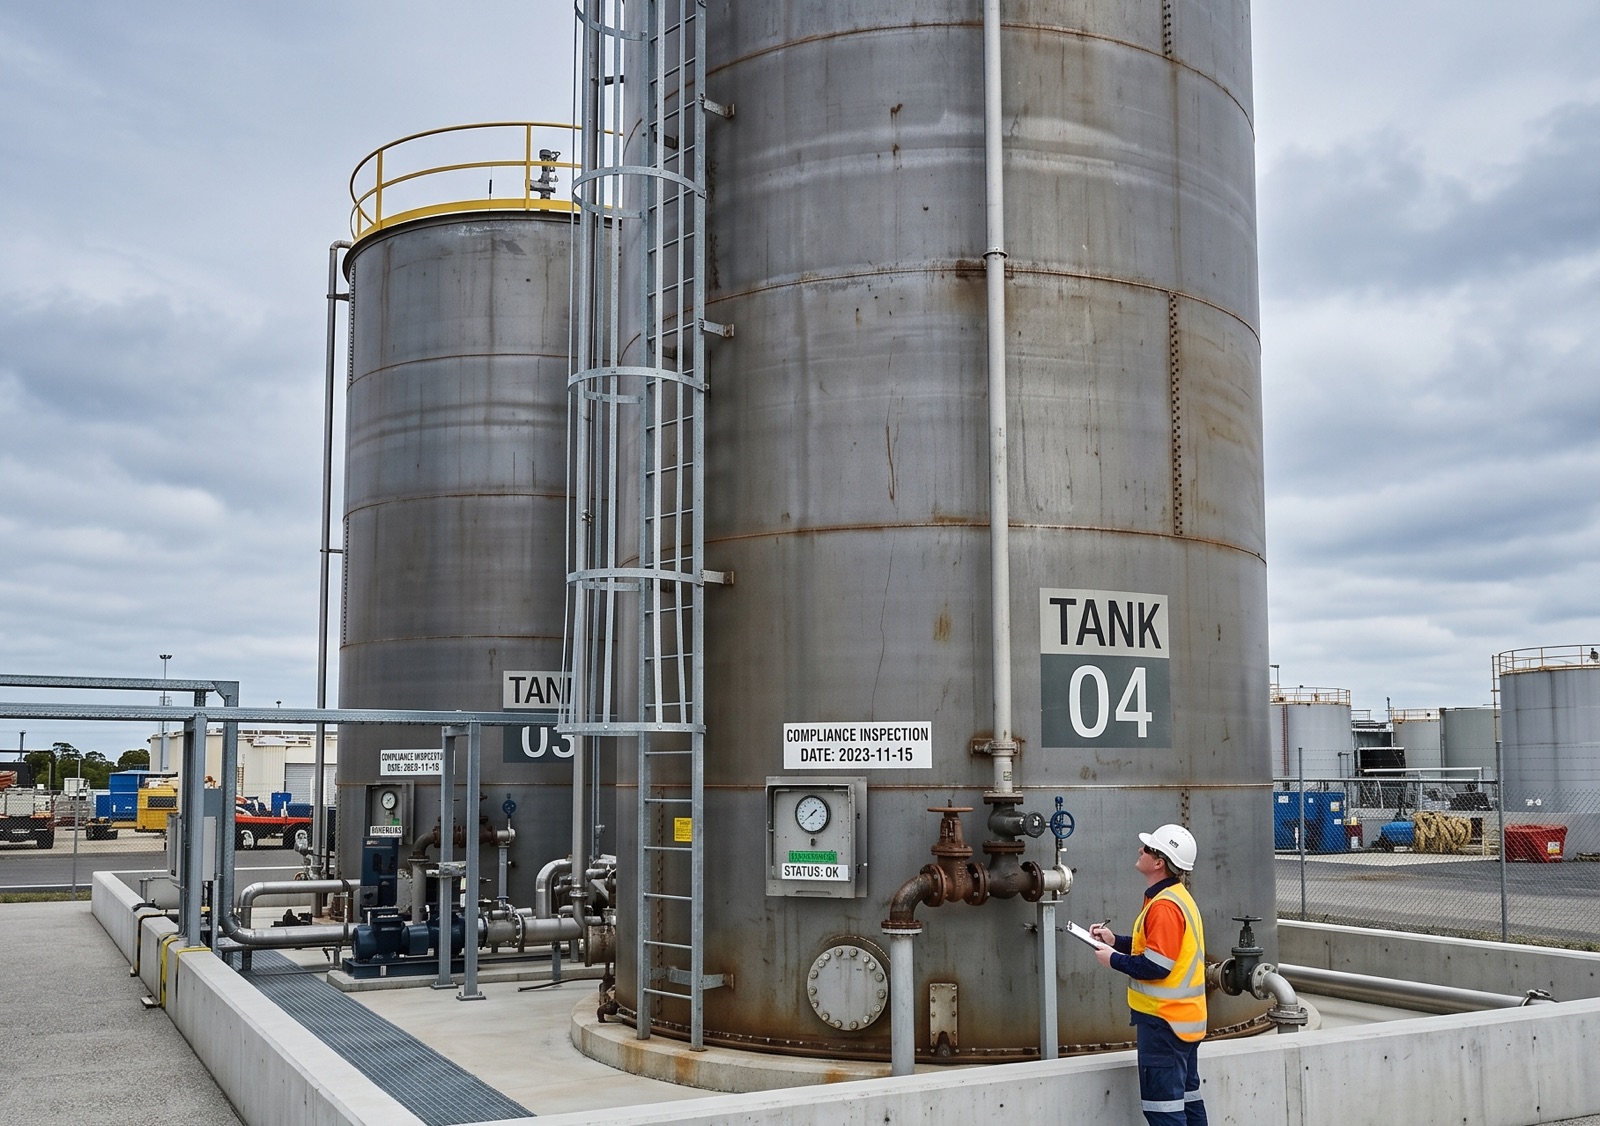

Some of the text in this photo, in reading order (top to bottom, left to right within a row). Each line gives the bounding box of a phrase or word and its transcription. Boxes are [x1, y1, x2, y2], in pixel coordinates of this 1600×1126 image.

[1050, 597, 1162, 649] TANK
[508, 676, 572, 705] TAN
[1069, 664, 1153, 739] 04
[786, 727, 929, 743] COMPLIANCE INSPECTION
[800, 747, 913, 762] DATE: 2023-11-15
[784, 865, 839, 878] STATUS: OK
